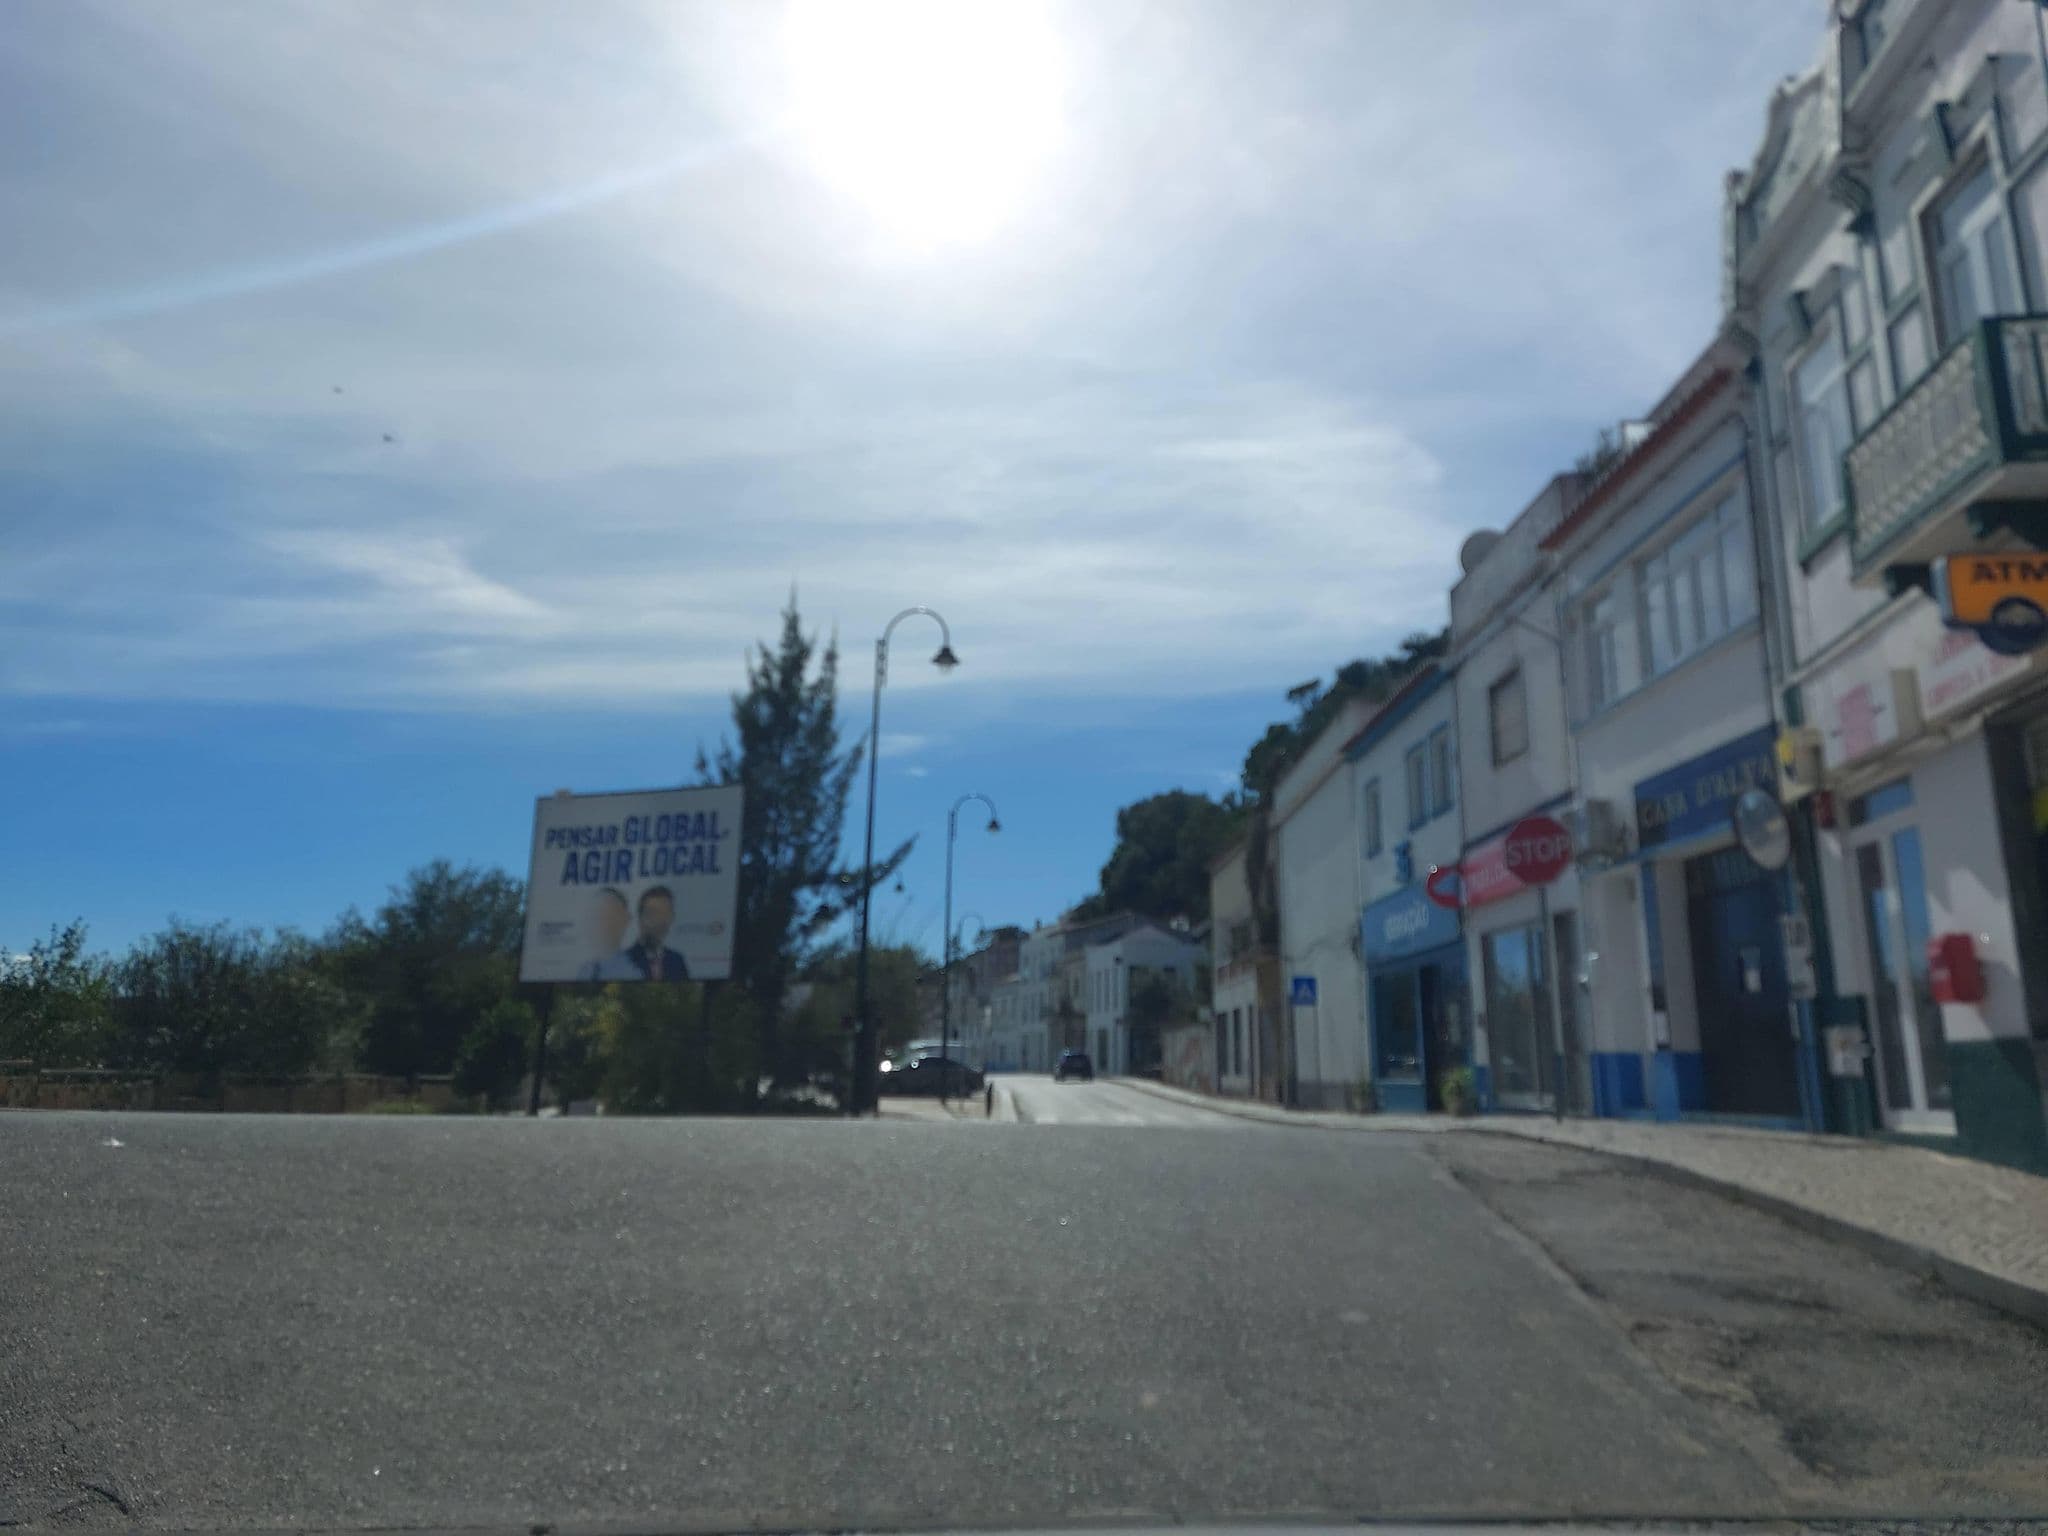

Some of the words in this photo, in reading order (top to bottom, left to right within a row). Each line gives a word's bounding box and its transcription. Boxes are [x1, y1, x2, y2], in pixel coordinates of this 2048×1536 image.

[1973, 560, 2048, 582] ATM
[545, 824, 619, 848] PENSAR
[1507, 835, 1569, 864] STOP
[561, 848, 633, 884] AGIR
[640, 845, 721, 877] LOCAL
